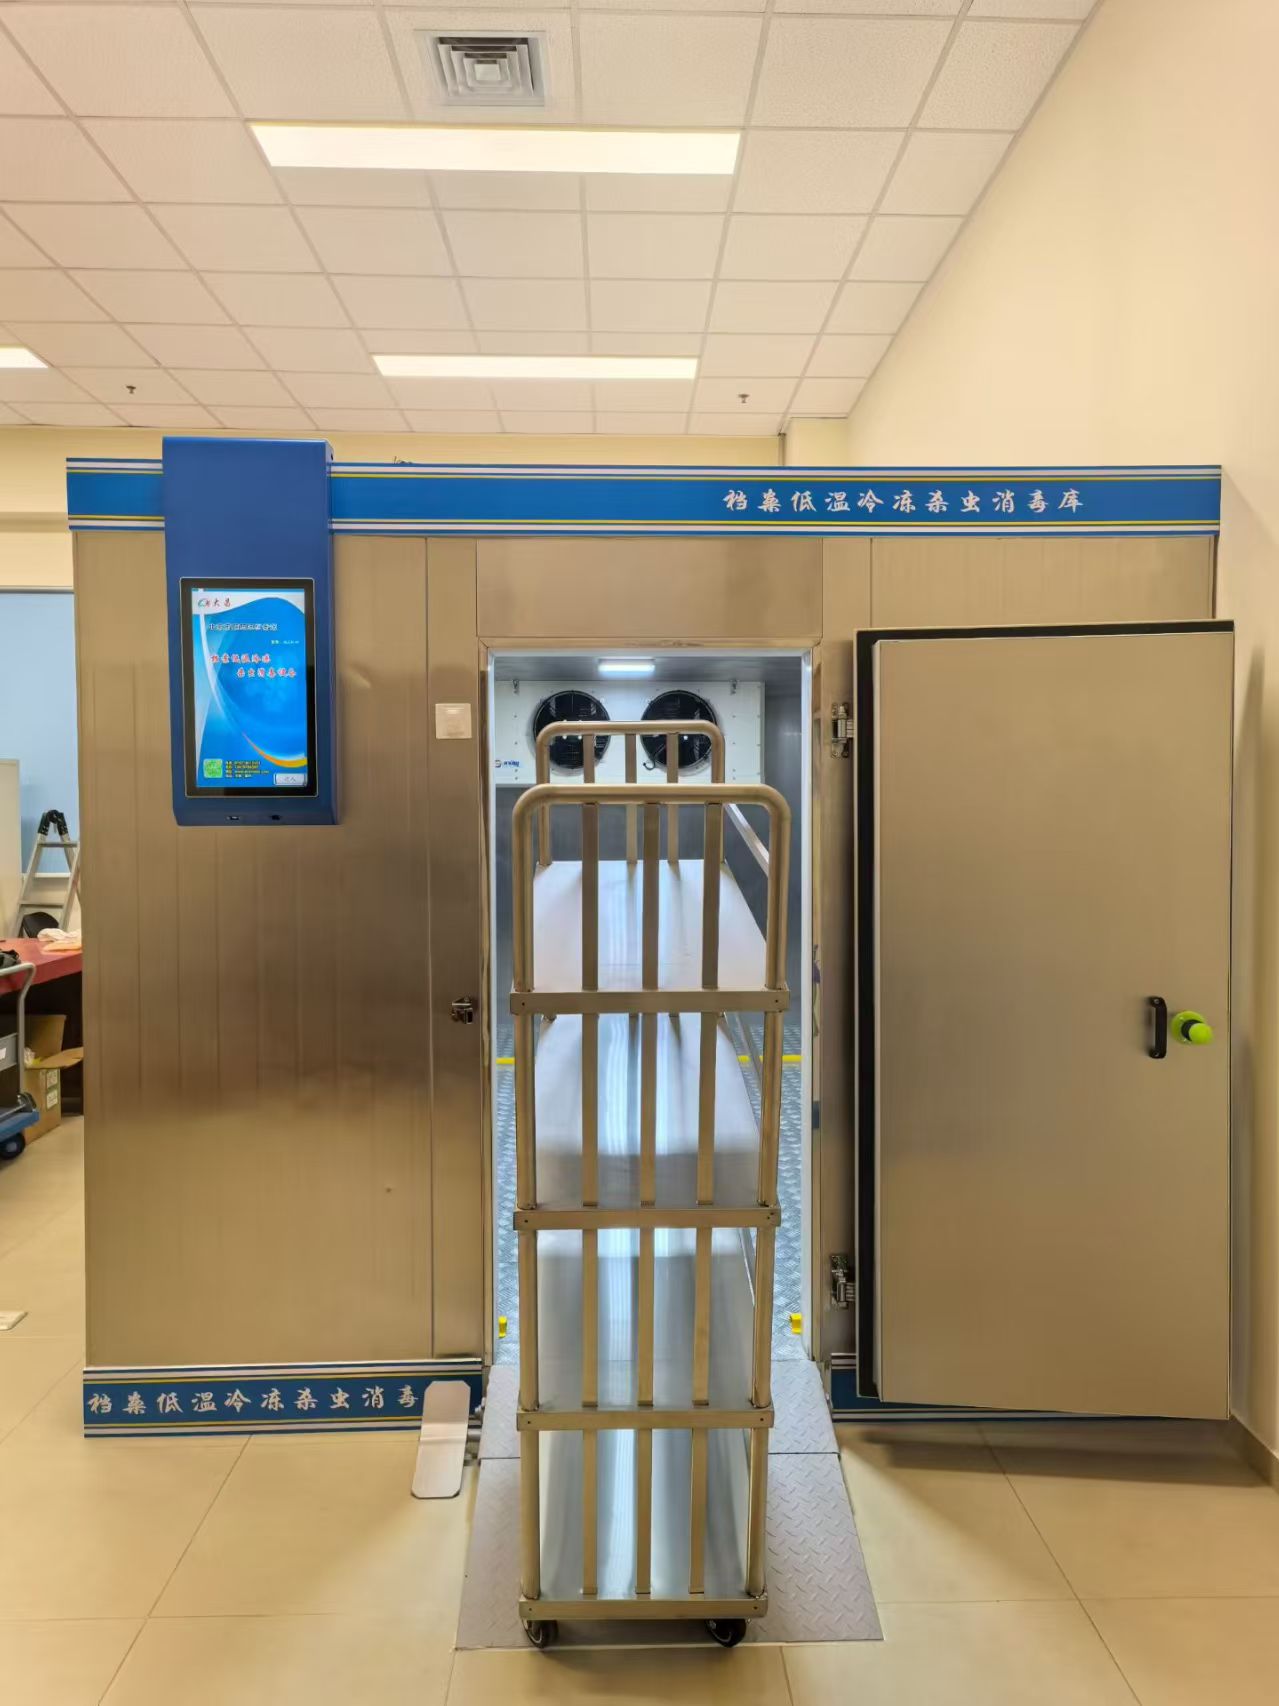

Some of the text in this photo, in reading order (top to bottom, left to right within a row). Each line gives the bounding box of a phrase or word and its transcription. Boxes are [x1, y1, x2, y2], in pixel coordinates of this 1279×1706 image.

[723, 488, 1084, 514] 档案低温冷冻杀虫消毒库
[87, 1385, 419, 1416] 档案低温冷冻杀虫消毒
